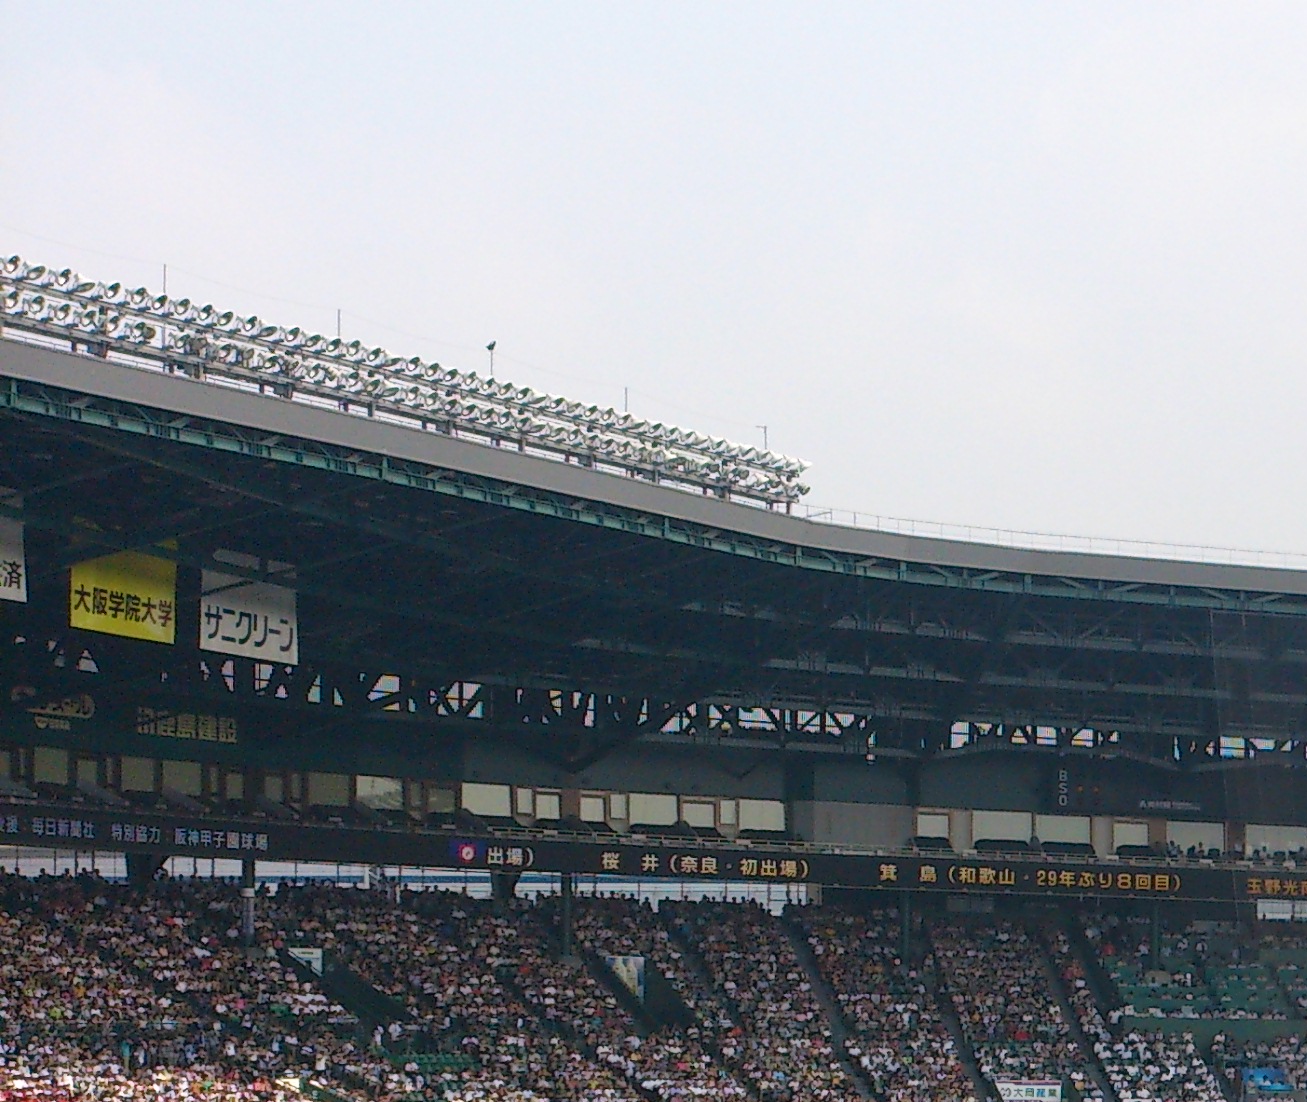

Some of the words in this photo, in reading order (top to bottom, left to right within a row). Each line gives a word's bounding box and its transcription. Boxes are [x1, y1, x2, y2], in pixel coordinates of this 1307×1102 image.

[0, 560, 22, 590] 済
[74, 584, 173, 627] 大阪学院大学
[204, 605, 293, 651] サニクリーン
